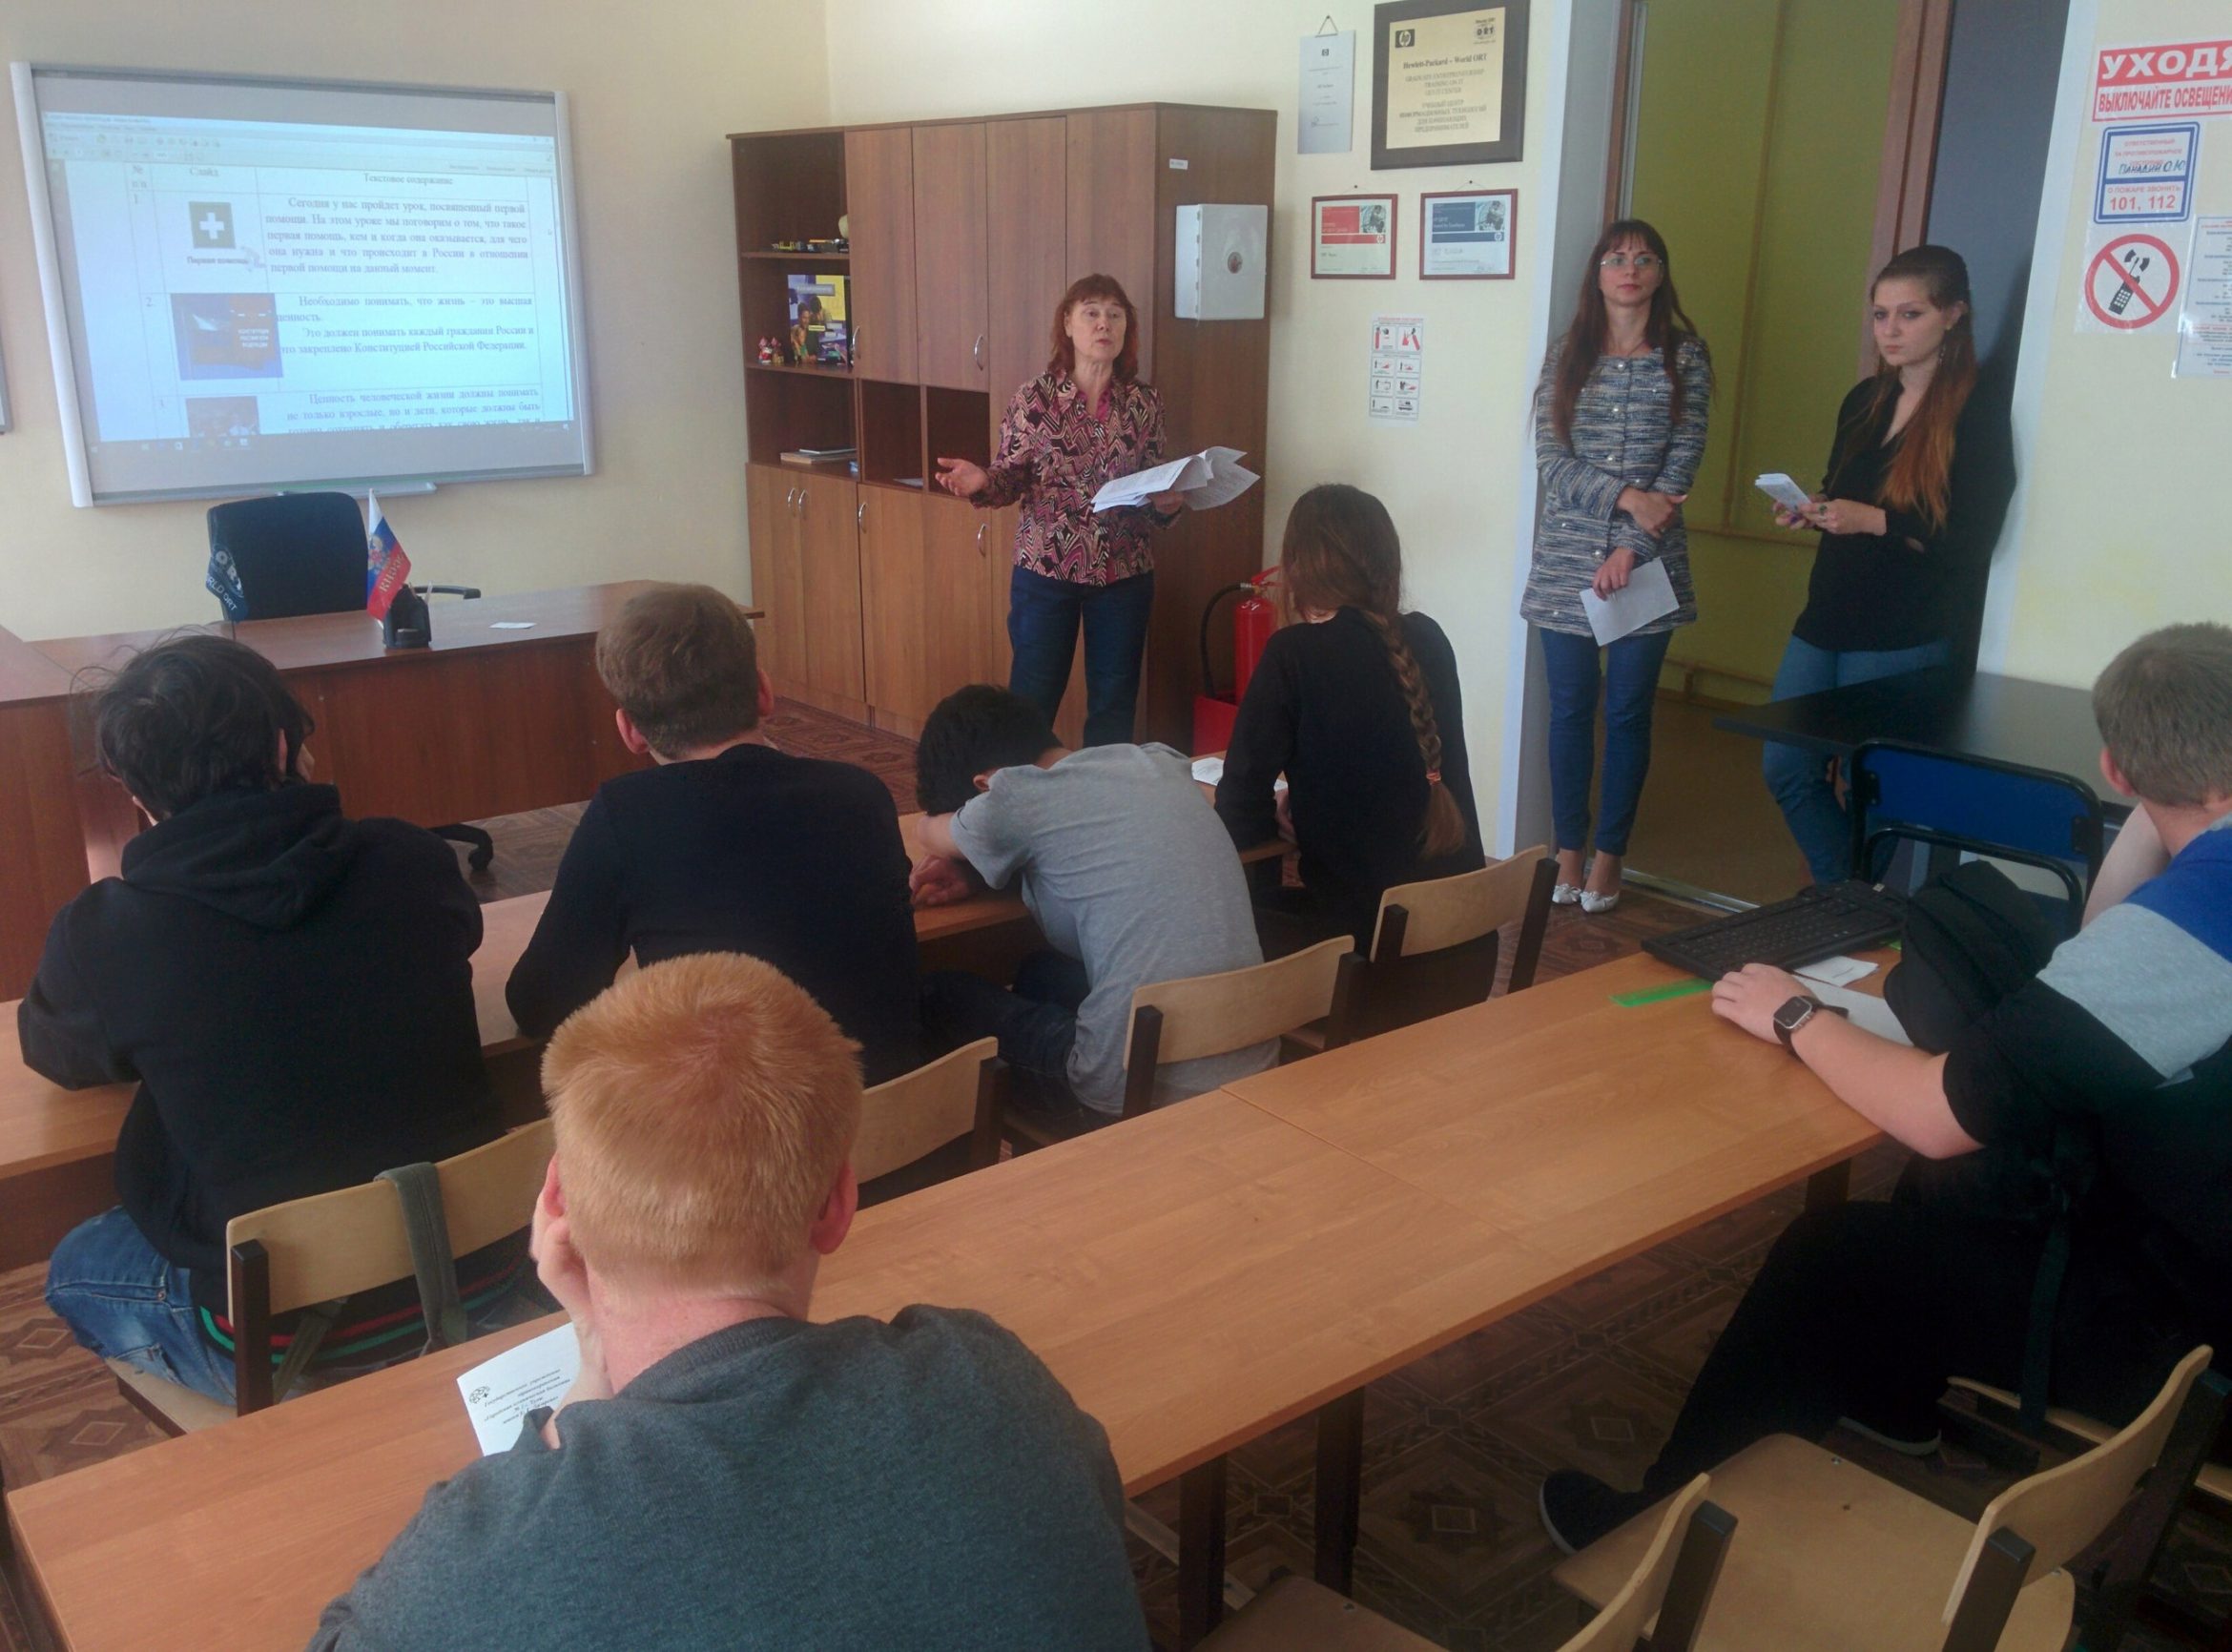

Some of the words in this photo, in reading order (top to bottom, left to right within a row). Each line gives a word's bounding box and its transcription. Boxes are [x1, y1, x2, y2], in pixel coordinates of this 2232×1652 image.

[1403, 57, 1448, 69] Hewlett-Packard
[2098, 86, 2172, 113] ВЫКЛЮЧАЙТЕ
[190, 168, 218, 177] Слайд
[364, 174, 404, 183] Текстовое
[406, 176, 453, 186] содержание
[288, 197, 329, 208] Сегодня
[403, 203, 427, 213] урок,
[430, 202, 491, 213] посвященный
[494, 203, 525, 215] первой
[2148, 195, 2176, 209] 112
[265, 215, 306, 224] помощи.
[312, 214, 326, 224] На
[330, 217, 352, 225] этом
[355, 217, 382, 228] уроке
[385, 217, 400, 226] мы
[403, 218, 451, 229] поговорим
[464, 219, 482, 229] том,
[503, 220, 527, 229] такое
[267, 232, 300, 242] первая
[304, 232, 346, 241] помощь,
[381, 234, 406, 242] когда
[429, 235, 486, 244] оказывается,
[186, 256, 216, 265] Первая
[292, 248, 323, 258] нужна
[362, 248, 417, 259] происходит
[432, 248, 465, 258] России
[480, 250, 528, 258] отношении
[270, 263, 305, 275] первой
[308, 264, 347, 274] помощи
[364, 262, 400, 274] данный
[299, 296, 360, 306] Необходимо
[364, 298, 413, 307] понимать,
[302, 327, 320, 337] Это
[362, 328, 406, 337] понимать
[409, 326, 444, 336] каждый
[446, 327, 493, 338] гражданин
[496, 325, 525, 335] России
[300, 345, 352, 356] закреплено
[355, 342, 420, 354] Конституцией
[423, 341, 474, 351] Российской
[477, 341, 526, 352] Федерации.
[309, 393, 356, 404] Ценность
[360, 391, 422, 402] человеческой
[426, 391, 454, 400] жизни
[459, 390, 494, 399] должны
[498, 388, 539, 397] понимать
[303, 412, 335, 421] только
[340, 408, 383, 420] взрослые,
[414, 407, 437, 416] дети,
[441, 405, 477, 416] которые
[482, 403, 515, 413] должны
[519, 401, 540, 411] быть
[222, 592, 238, 610] ORT
